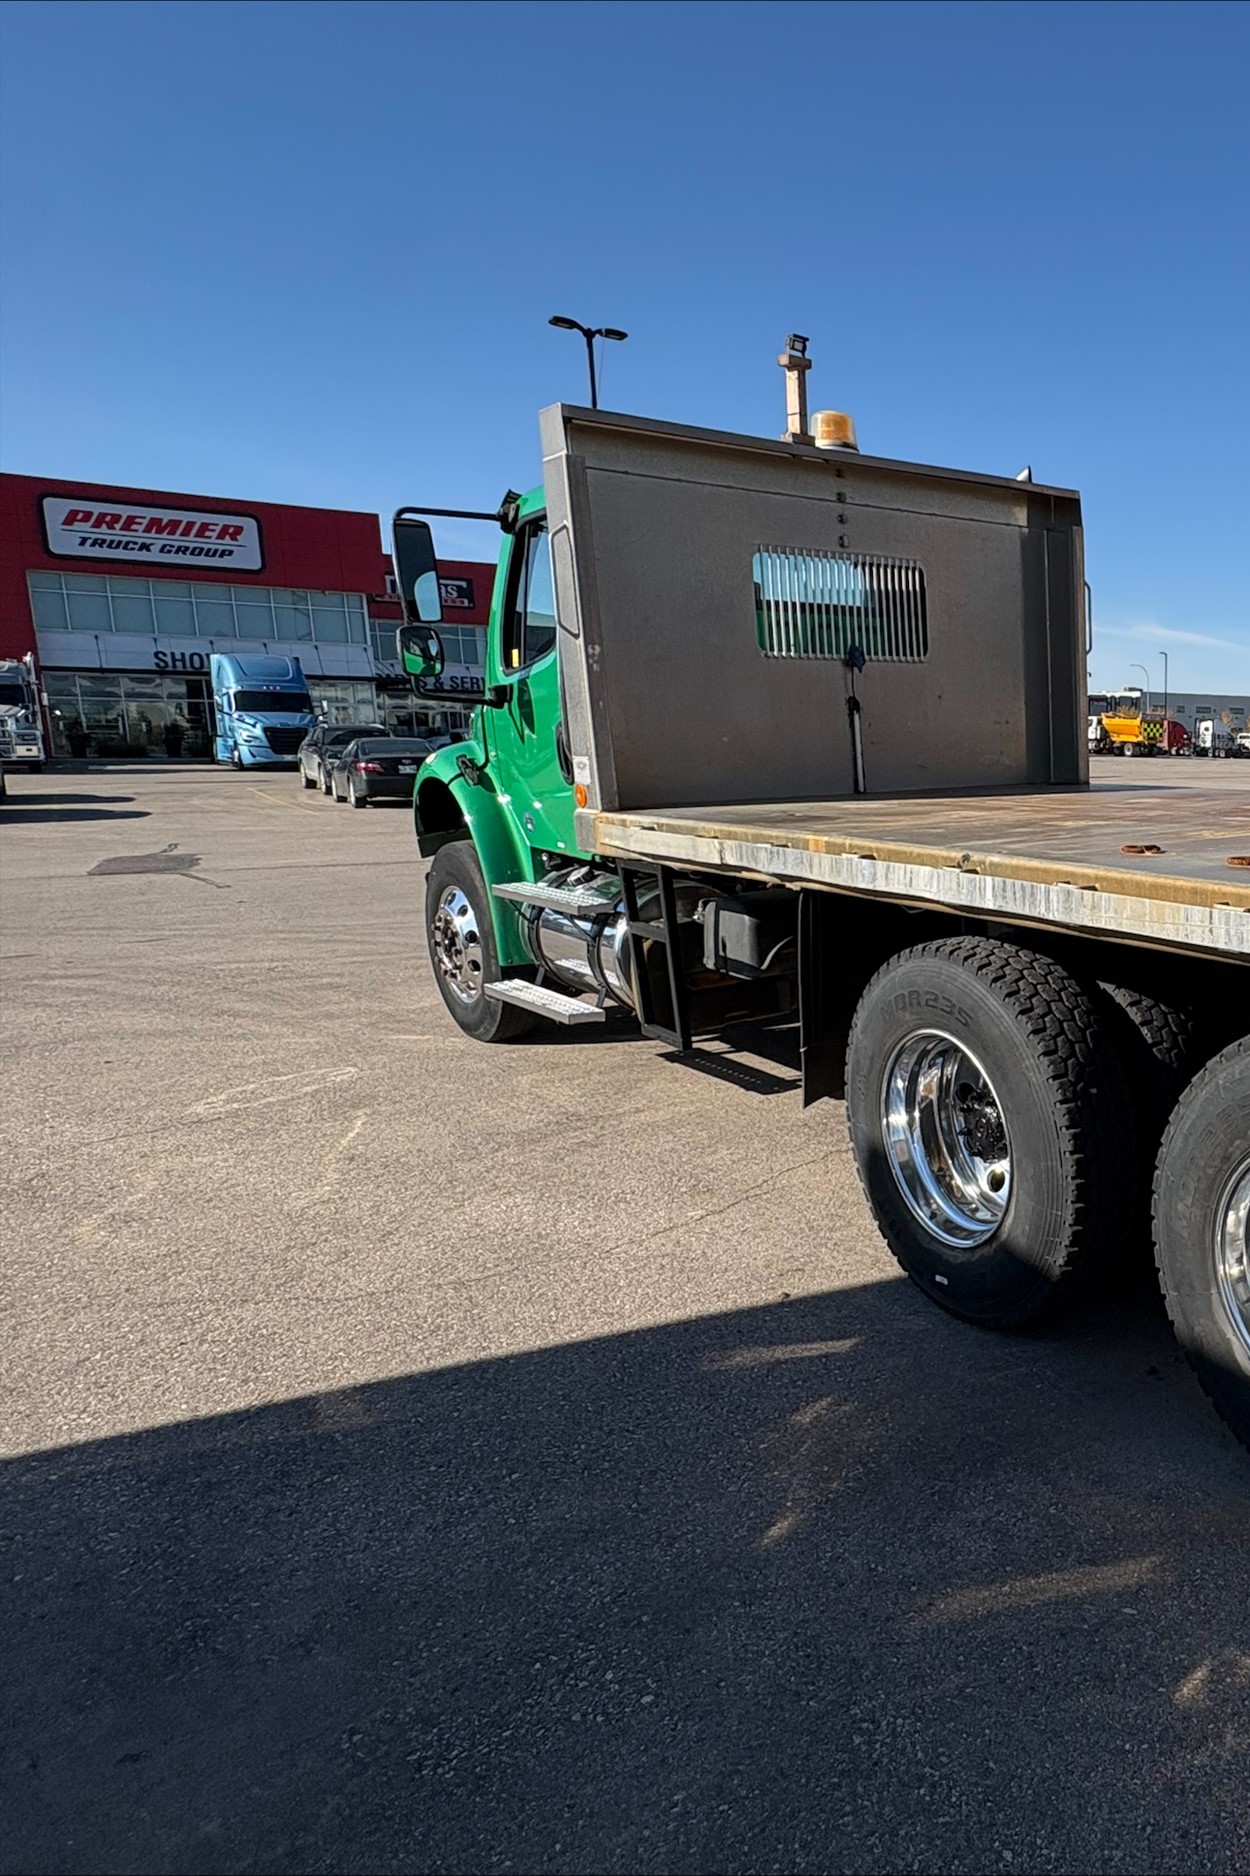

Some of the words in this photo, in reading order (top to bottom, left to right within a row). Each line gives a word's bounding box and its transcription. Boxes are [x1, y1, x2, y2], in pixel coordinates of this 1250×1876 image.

[61, 508, 244, 542] PREMIER
[77, 536, 155, 553] TRUCK
[158, 543, 235, 558] GROUP
